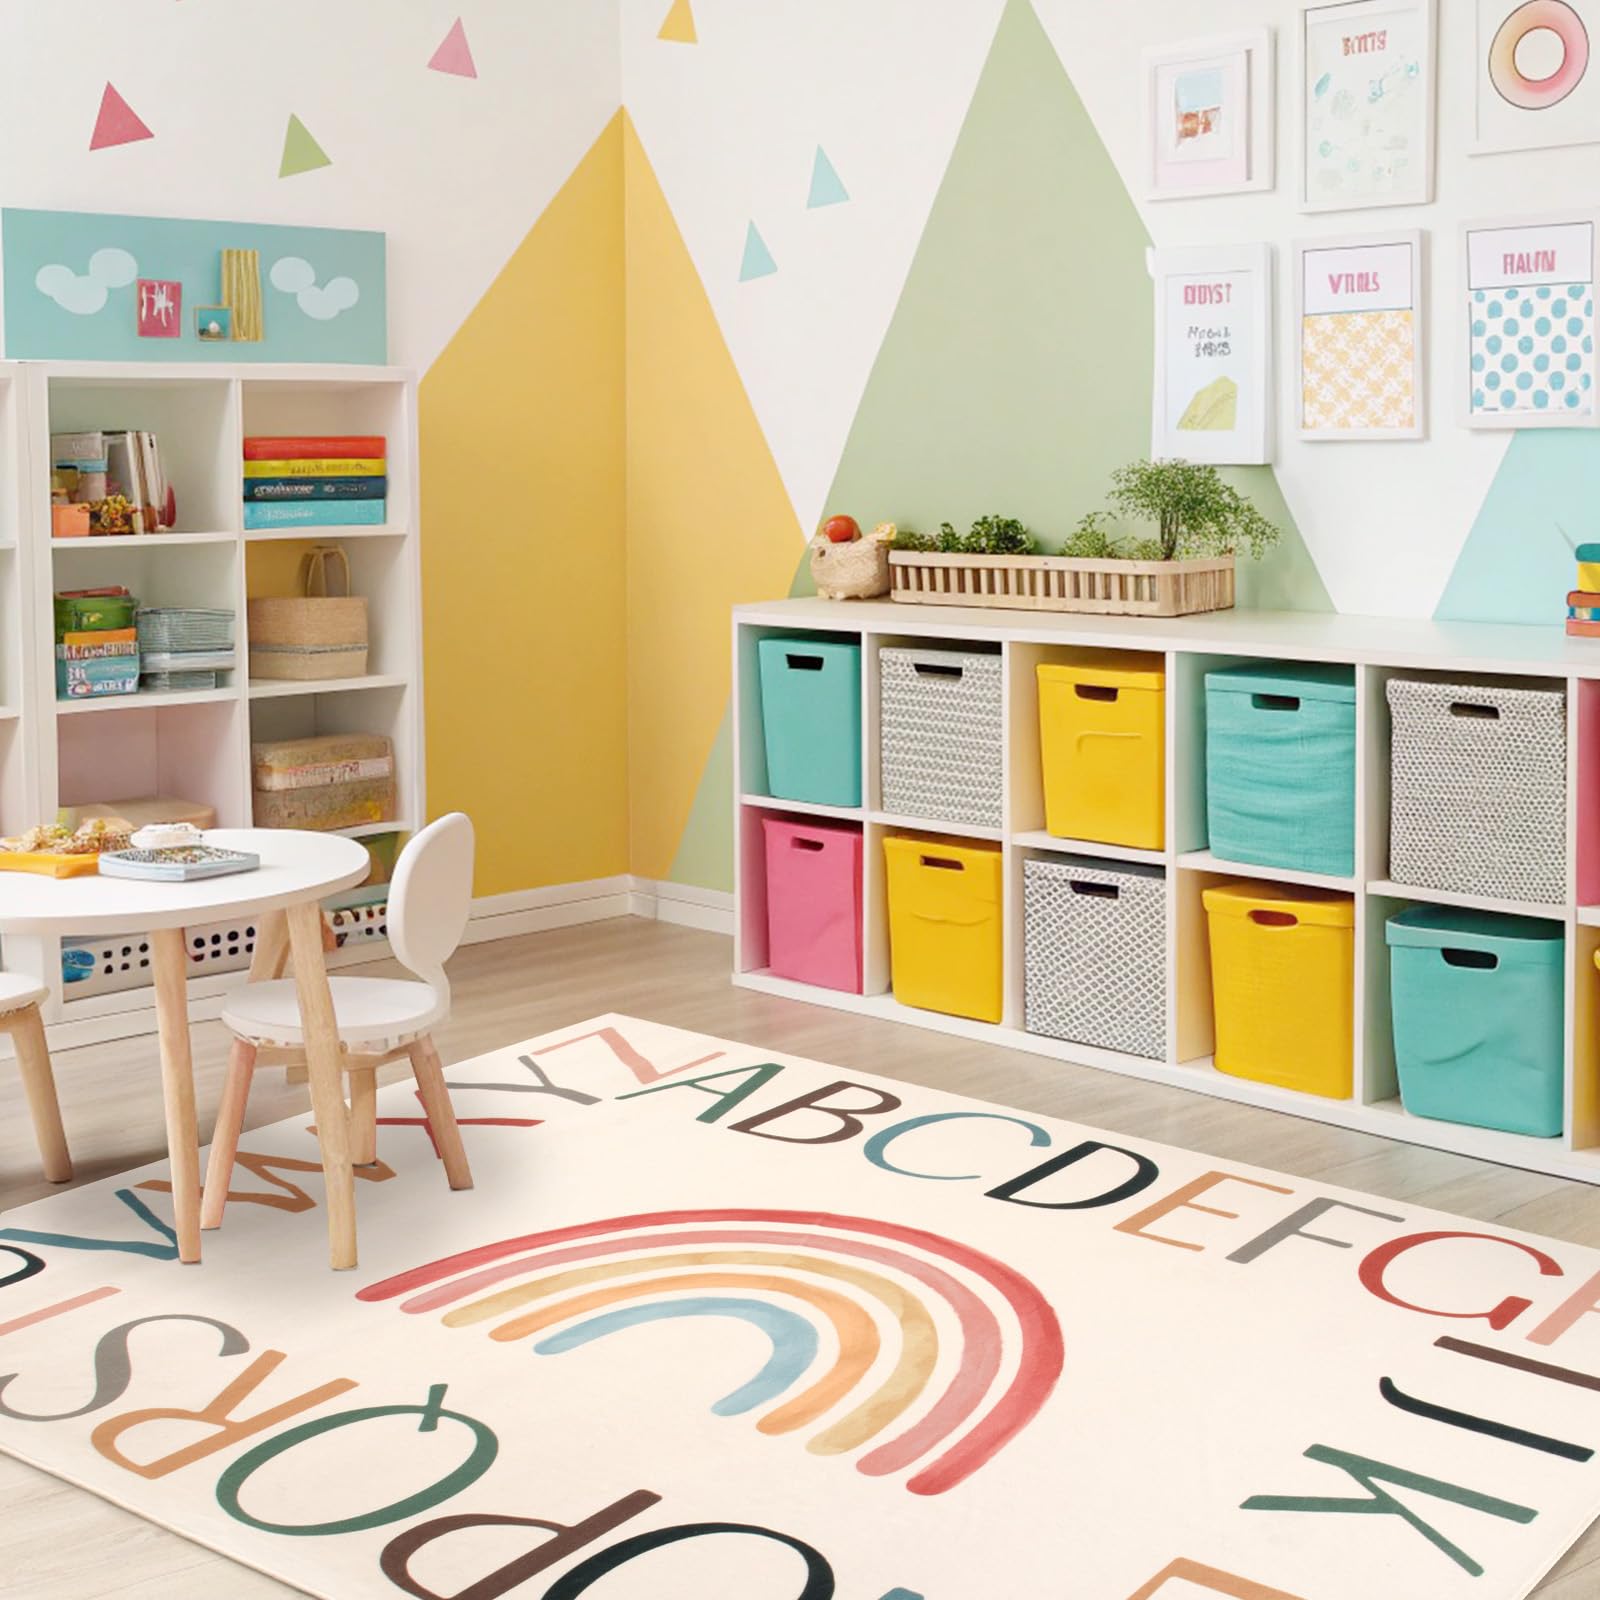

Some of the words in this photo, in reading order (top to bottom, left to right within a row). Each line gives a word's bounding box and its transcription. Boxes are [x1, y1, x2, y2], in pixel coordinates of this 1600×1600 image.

[532, 1027, 726, 1084] Z
[614, 1063, 785, 1124] A
[727, 1080, 902, 1144] B
[863, 1112, 1052, 1180] C
[984, 1140, 1160, 1210] D
[1113, 1170, 1295, 1252] E
[1225, 1197, 1405, 1264] F
[1358, 1230, 1564, 1331] G
[0, 1314, 250, 1422] S
[90, 1349, 359, 1480] R
[216, 1383, 498, 1536] Q
[1239, 1443, 1538, 1577] K
